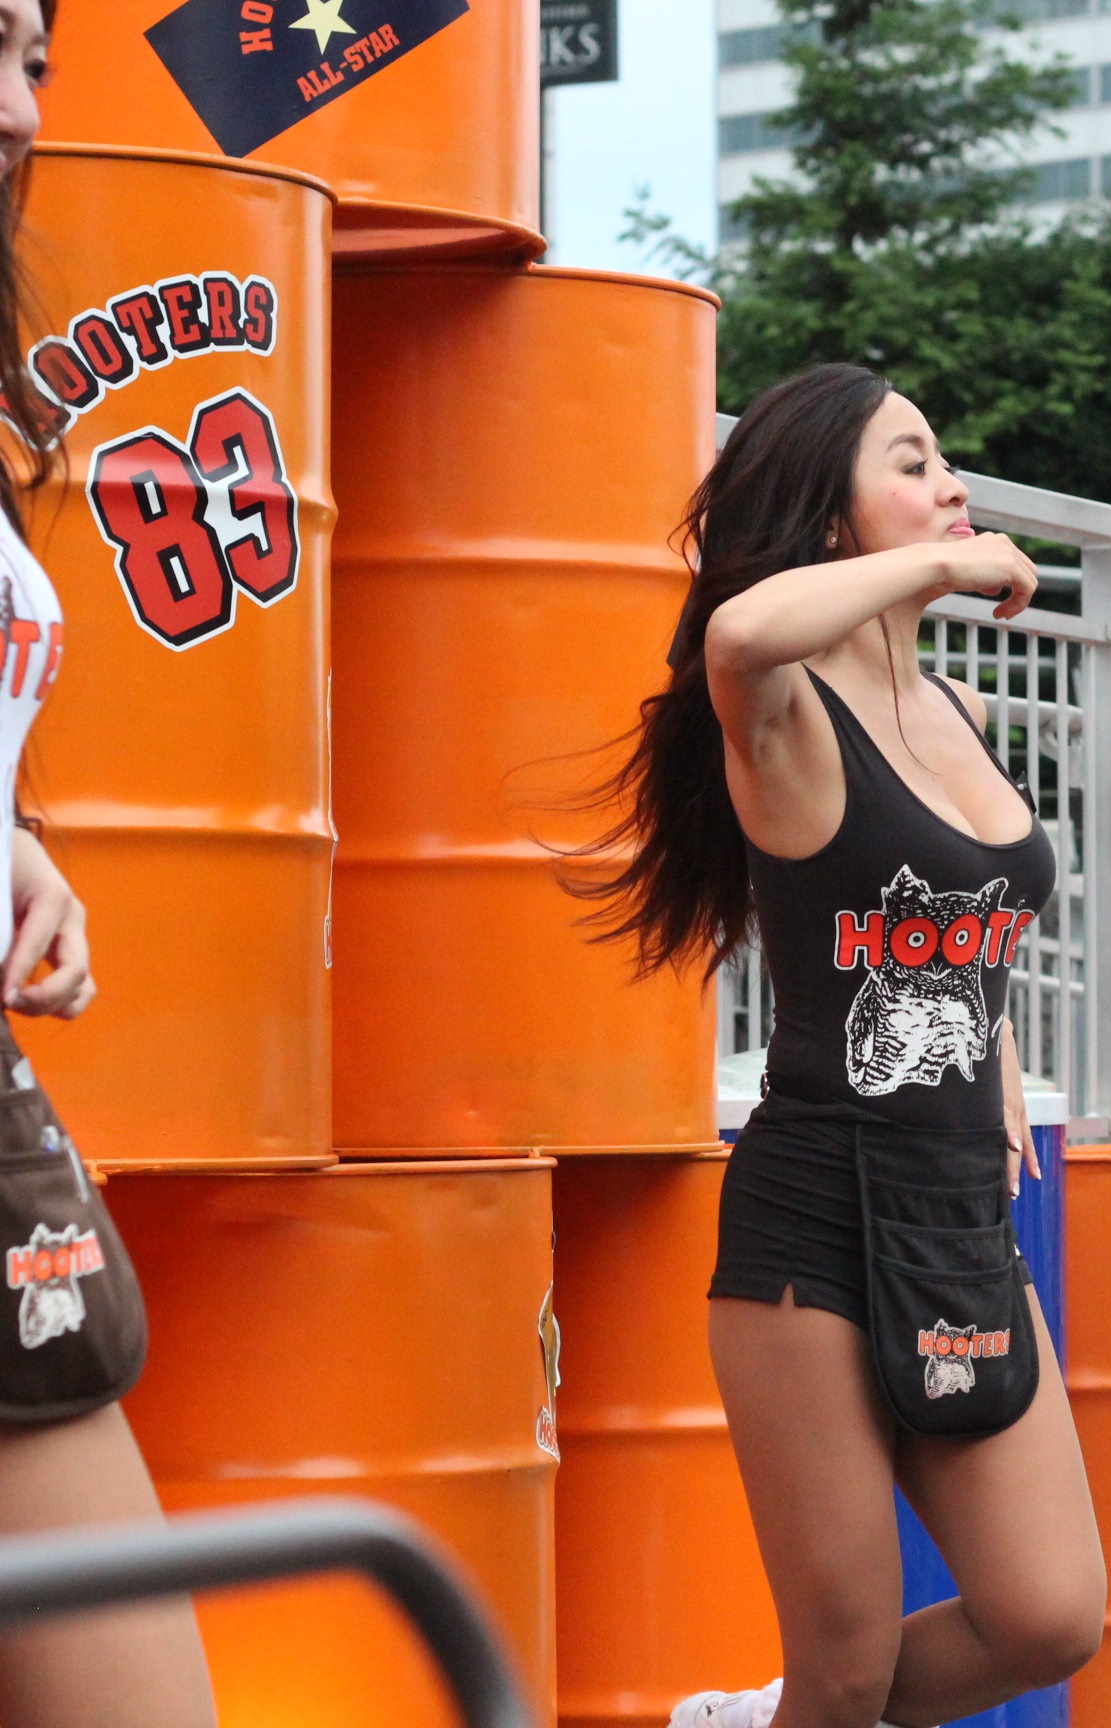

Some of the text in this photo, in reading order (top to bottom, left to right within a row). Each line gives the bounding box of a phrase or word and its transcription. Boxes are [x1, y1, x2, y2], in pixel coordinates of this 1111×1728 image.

[239, 0, 278, 55] HO
[296, 23, 400, 102] ALL-STAR
[88, 387, 300, 651] 83
